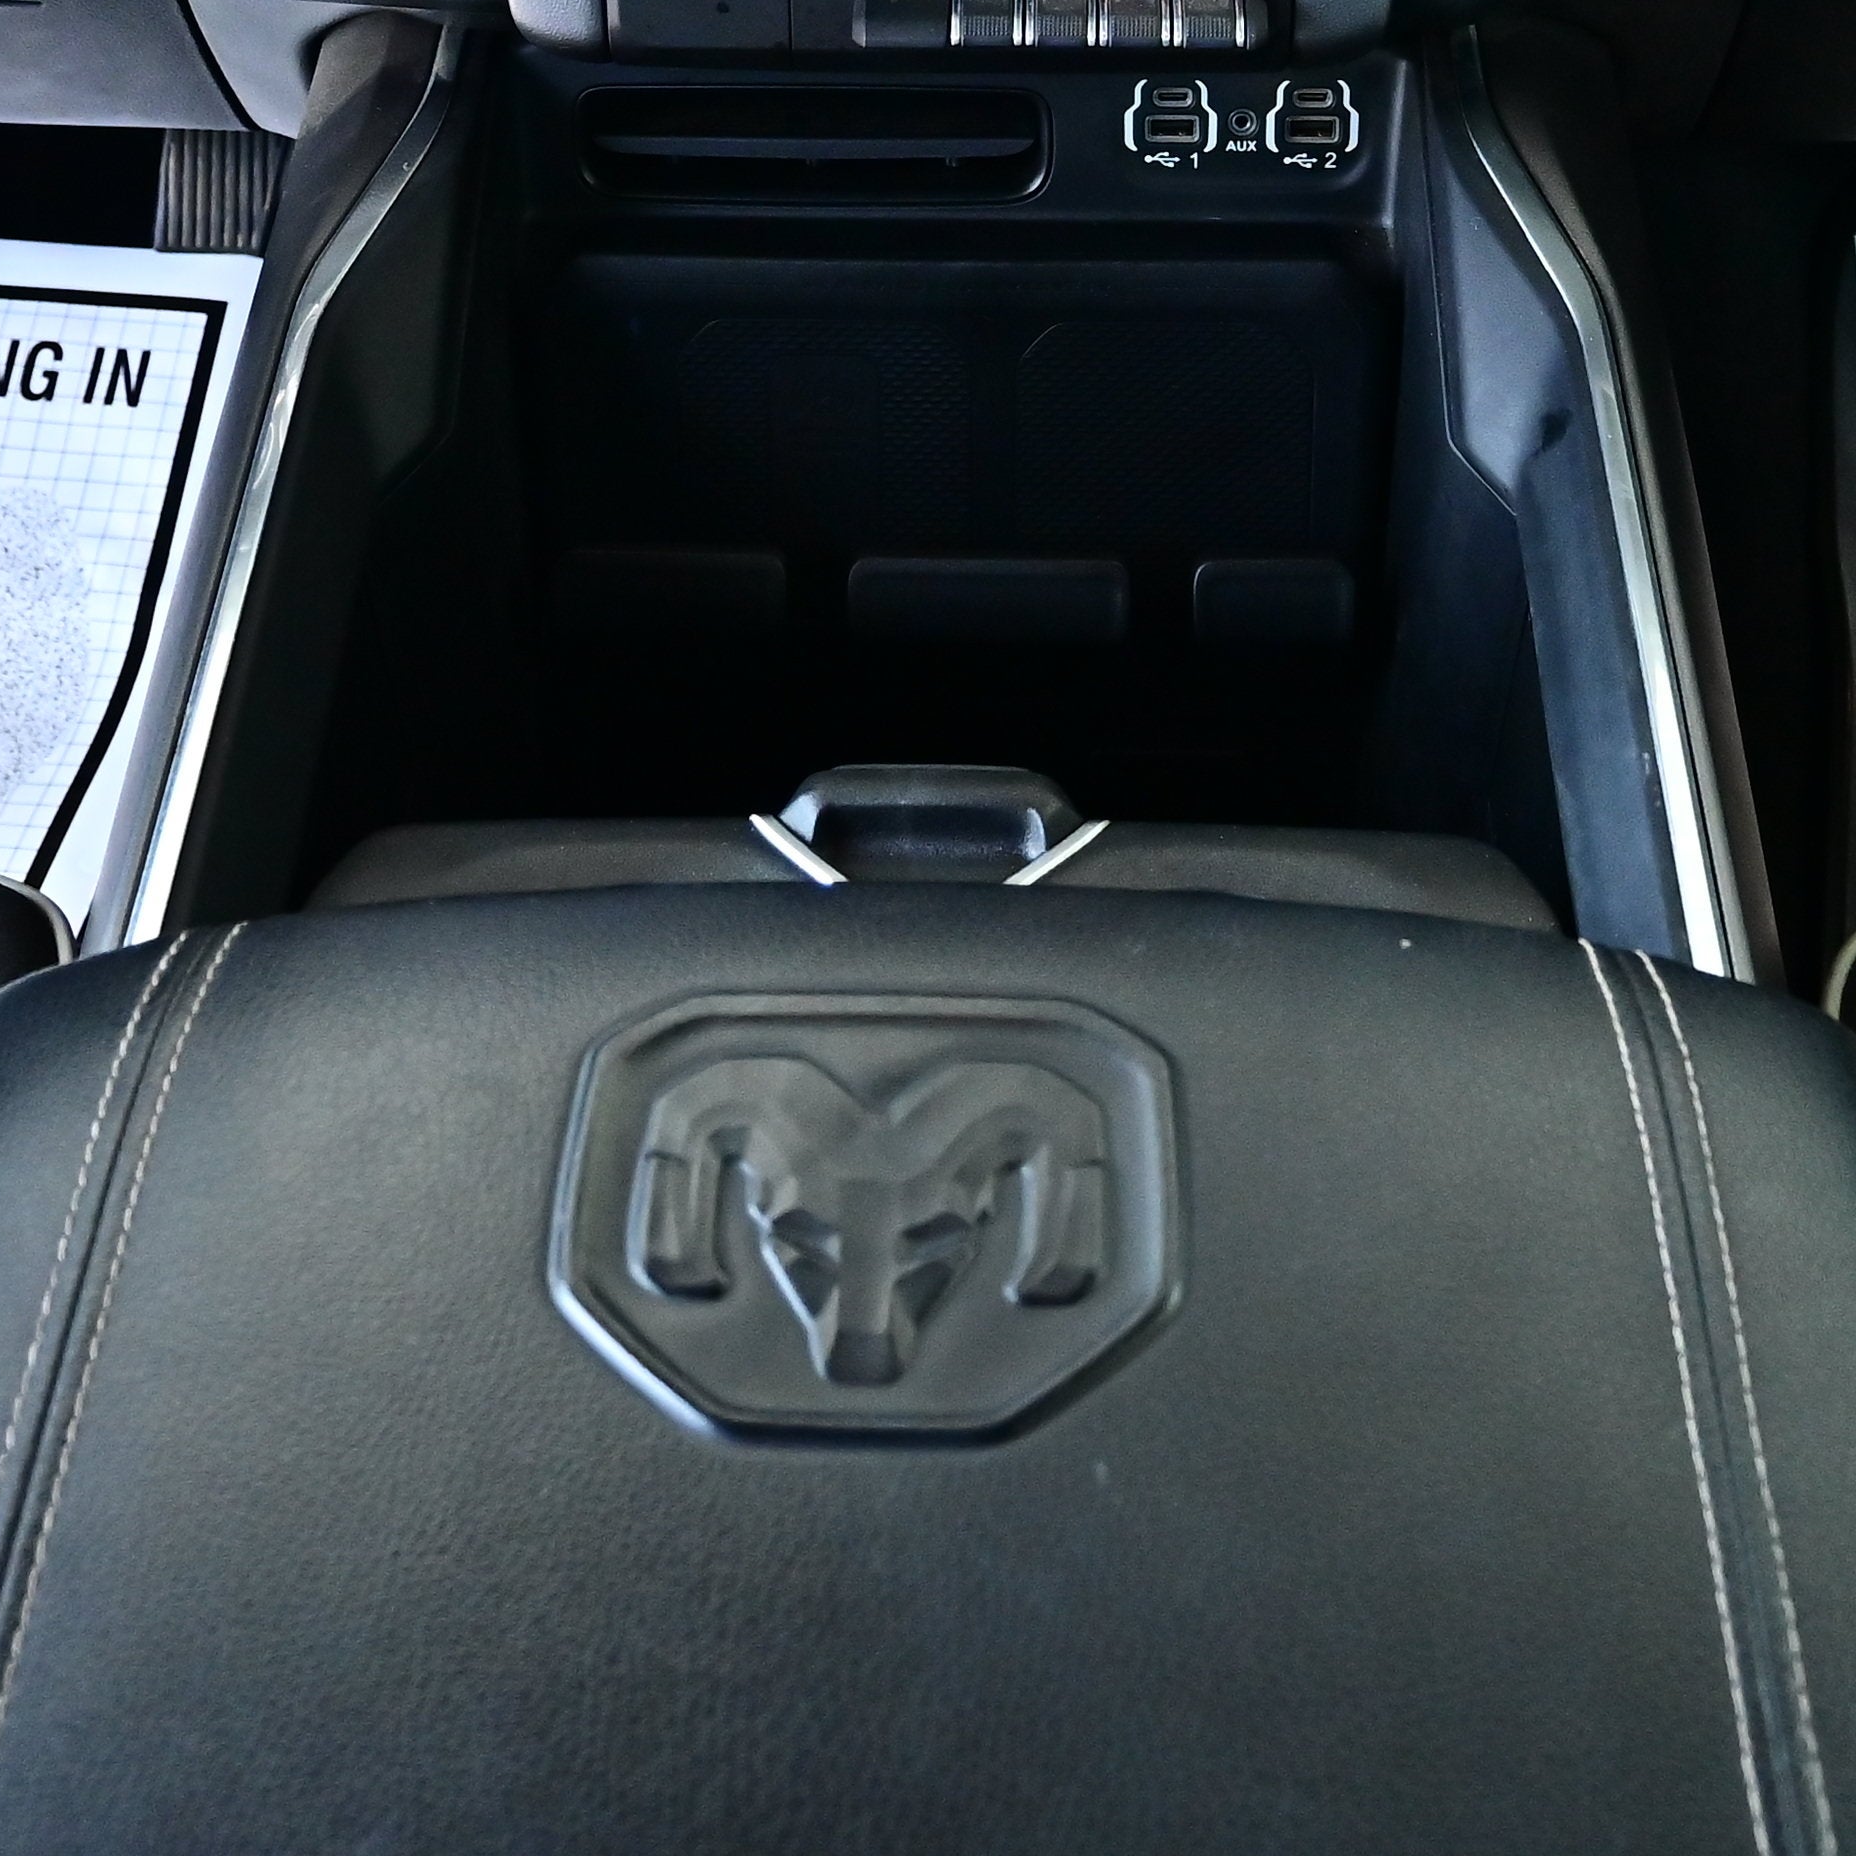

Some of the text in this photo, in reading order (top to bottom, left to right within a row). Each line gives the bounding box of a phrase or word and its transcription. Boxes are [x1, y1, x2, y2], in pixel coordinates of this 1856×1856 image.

[1225, 140, 1257, 152] AUX
[1189, 152, 1199, 169] 1
[1324, 152, 1338, 169] 2
[82, 346, 152, 408] IN
